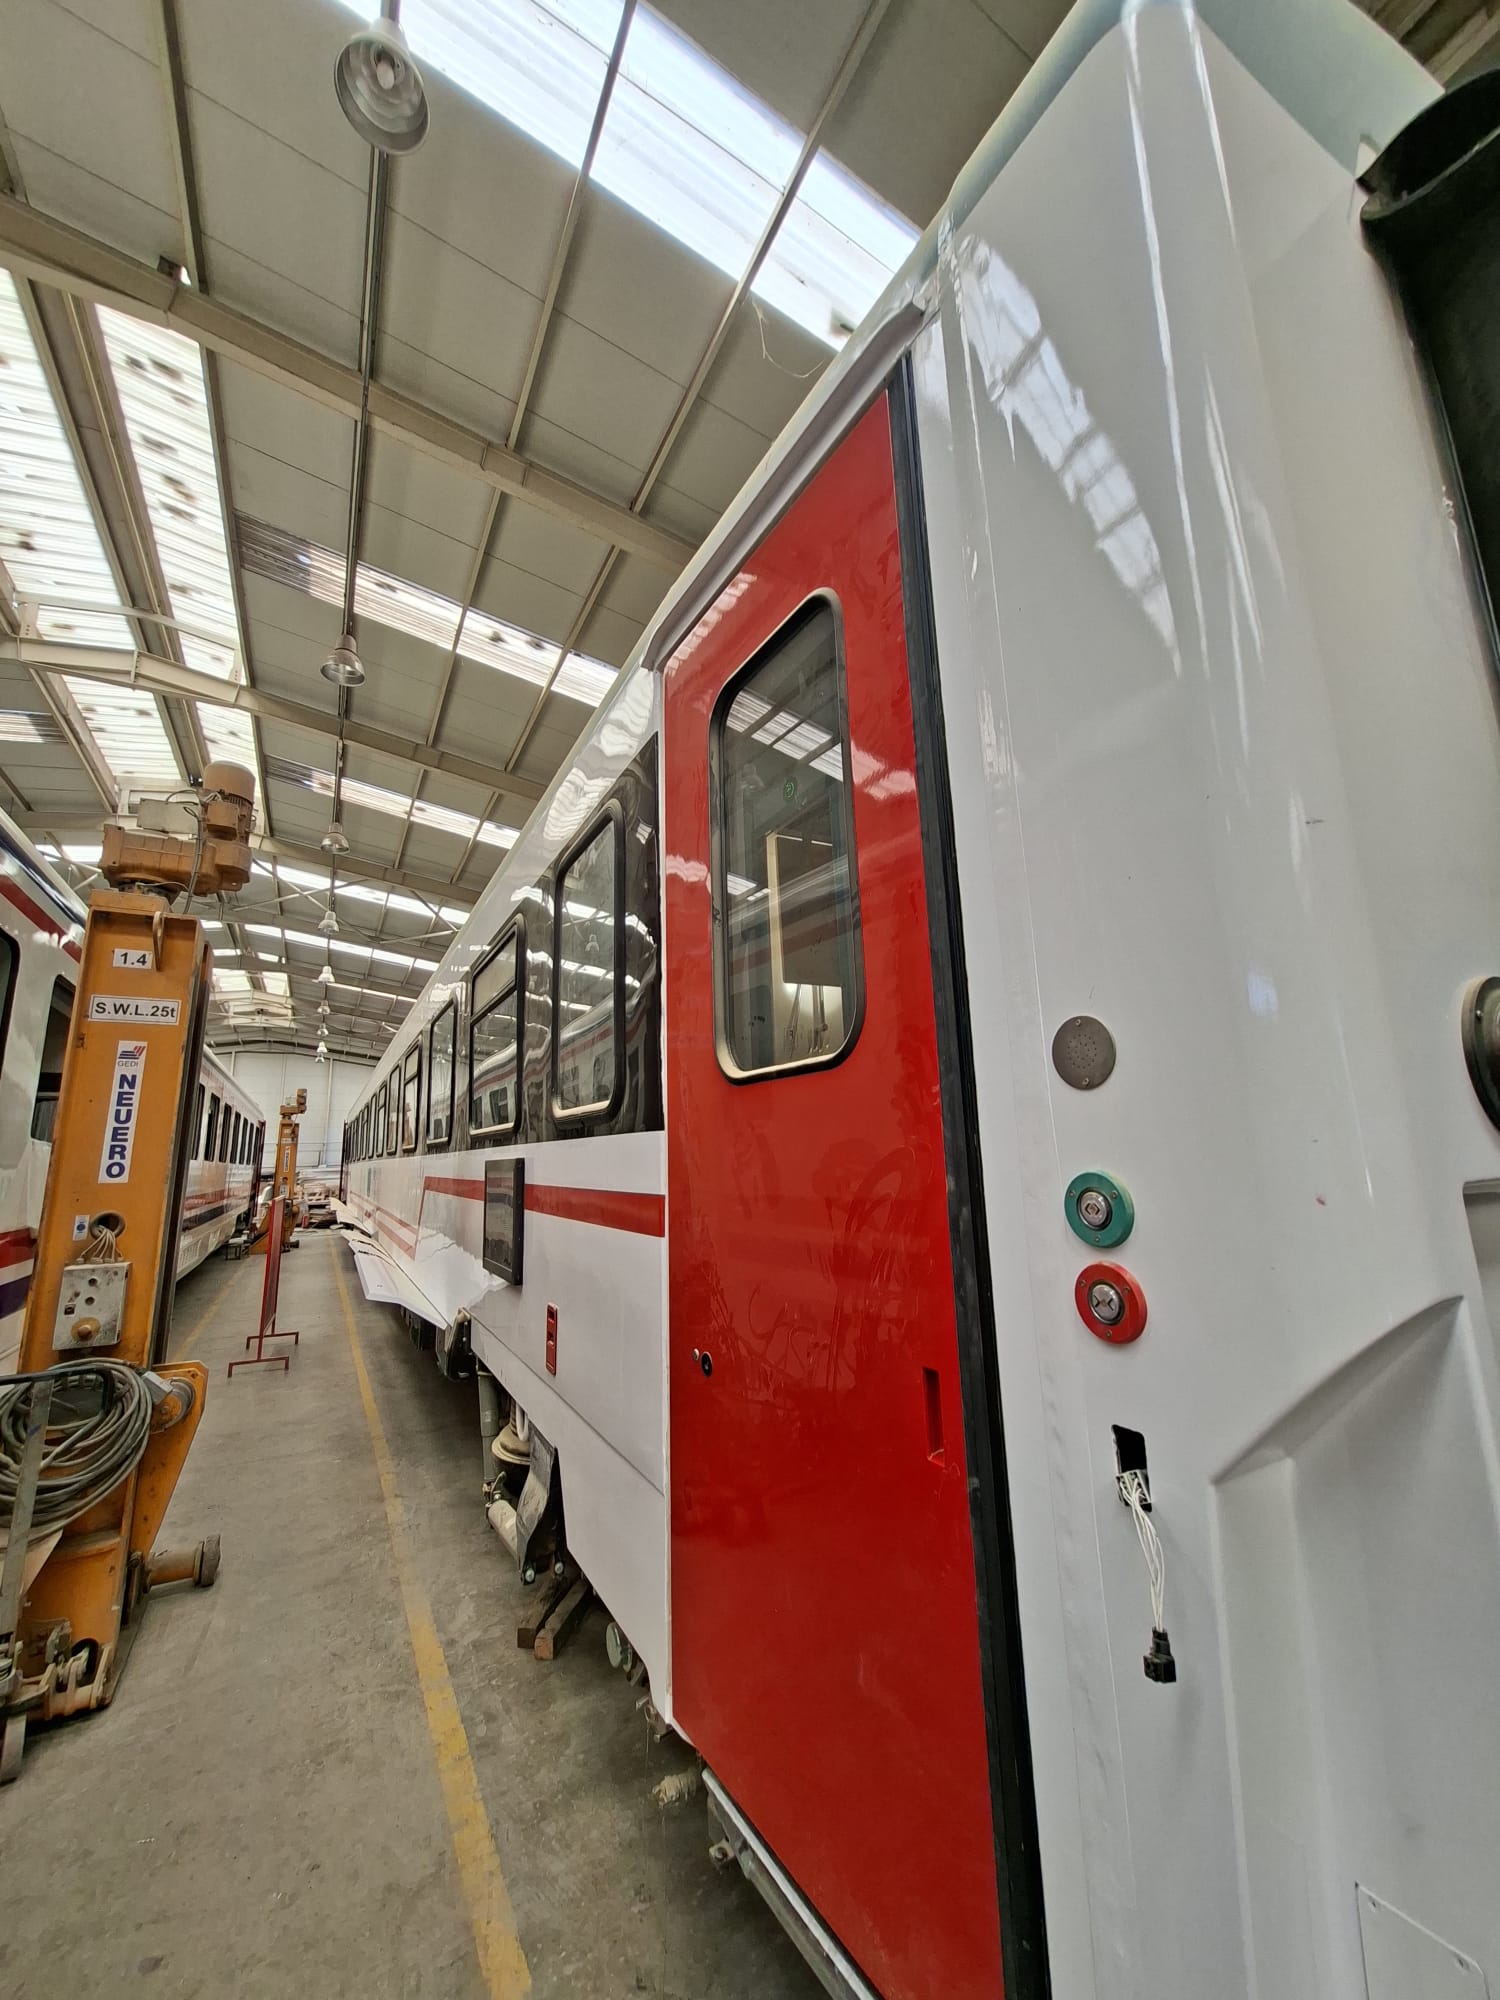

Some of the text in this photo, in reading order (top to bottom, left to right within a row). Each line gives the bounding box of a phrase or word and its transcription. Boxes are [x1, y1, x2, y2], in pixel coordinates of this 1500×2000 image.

[120, 952, 147, 966] 1.4
[95, 1002, 176, 1018] S.W.L.25t
[105, 1073, 138, 1180] NEUERO
